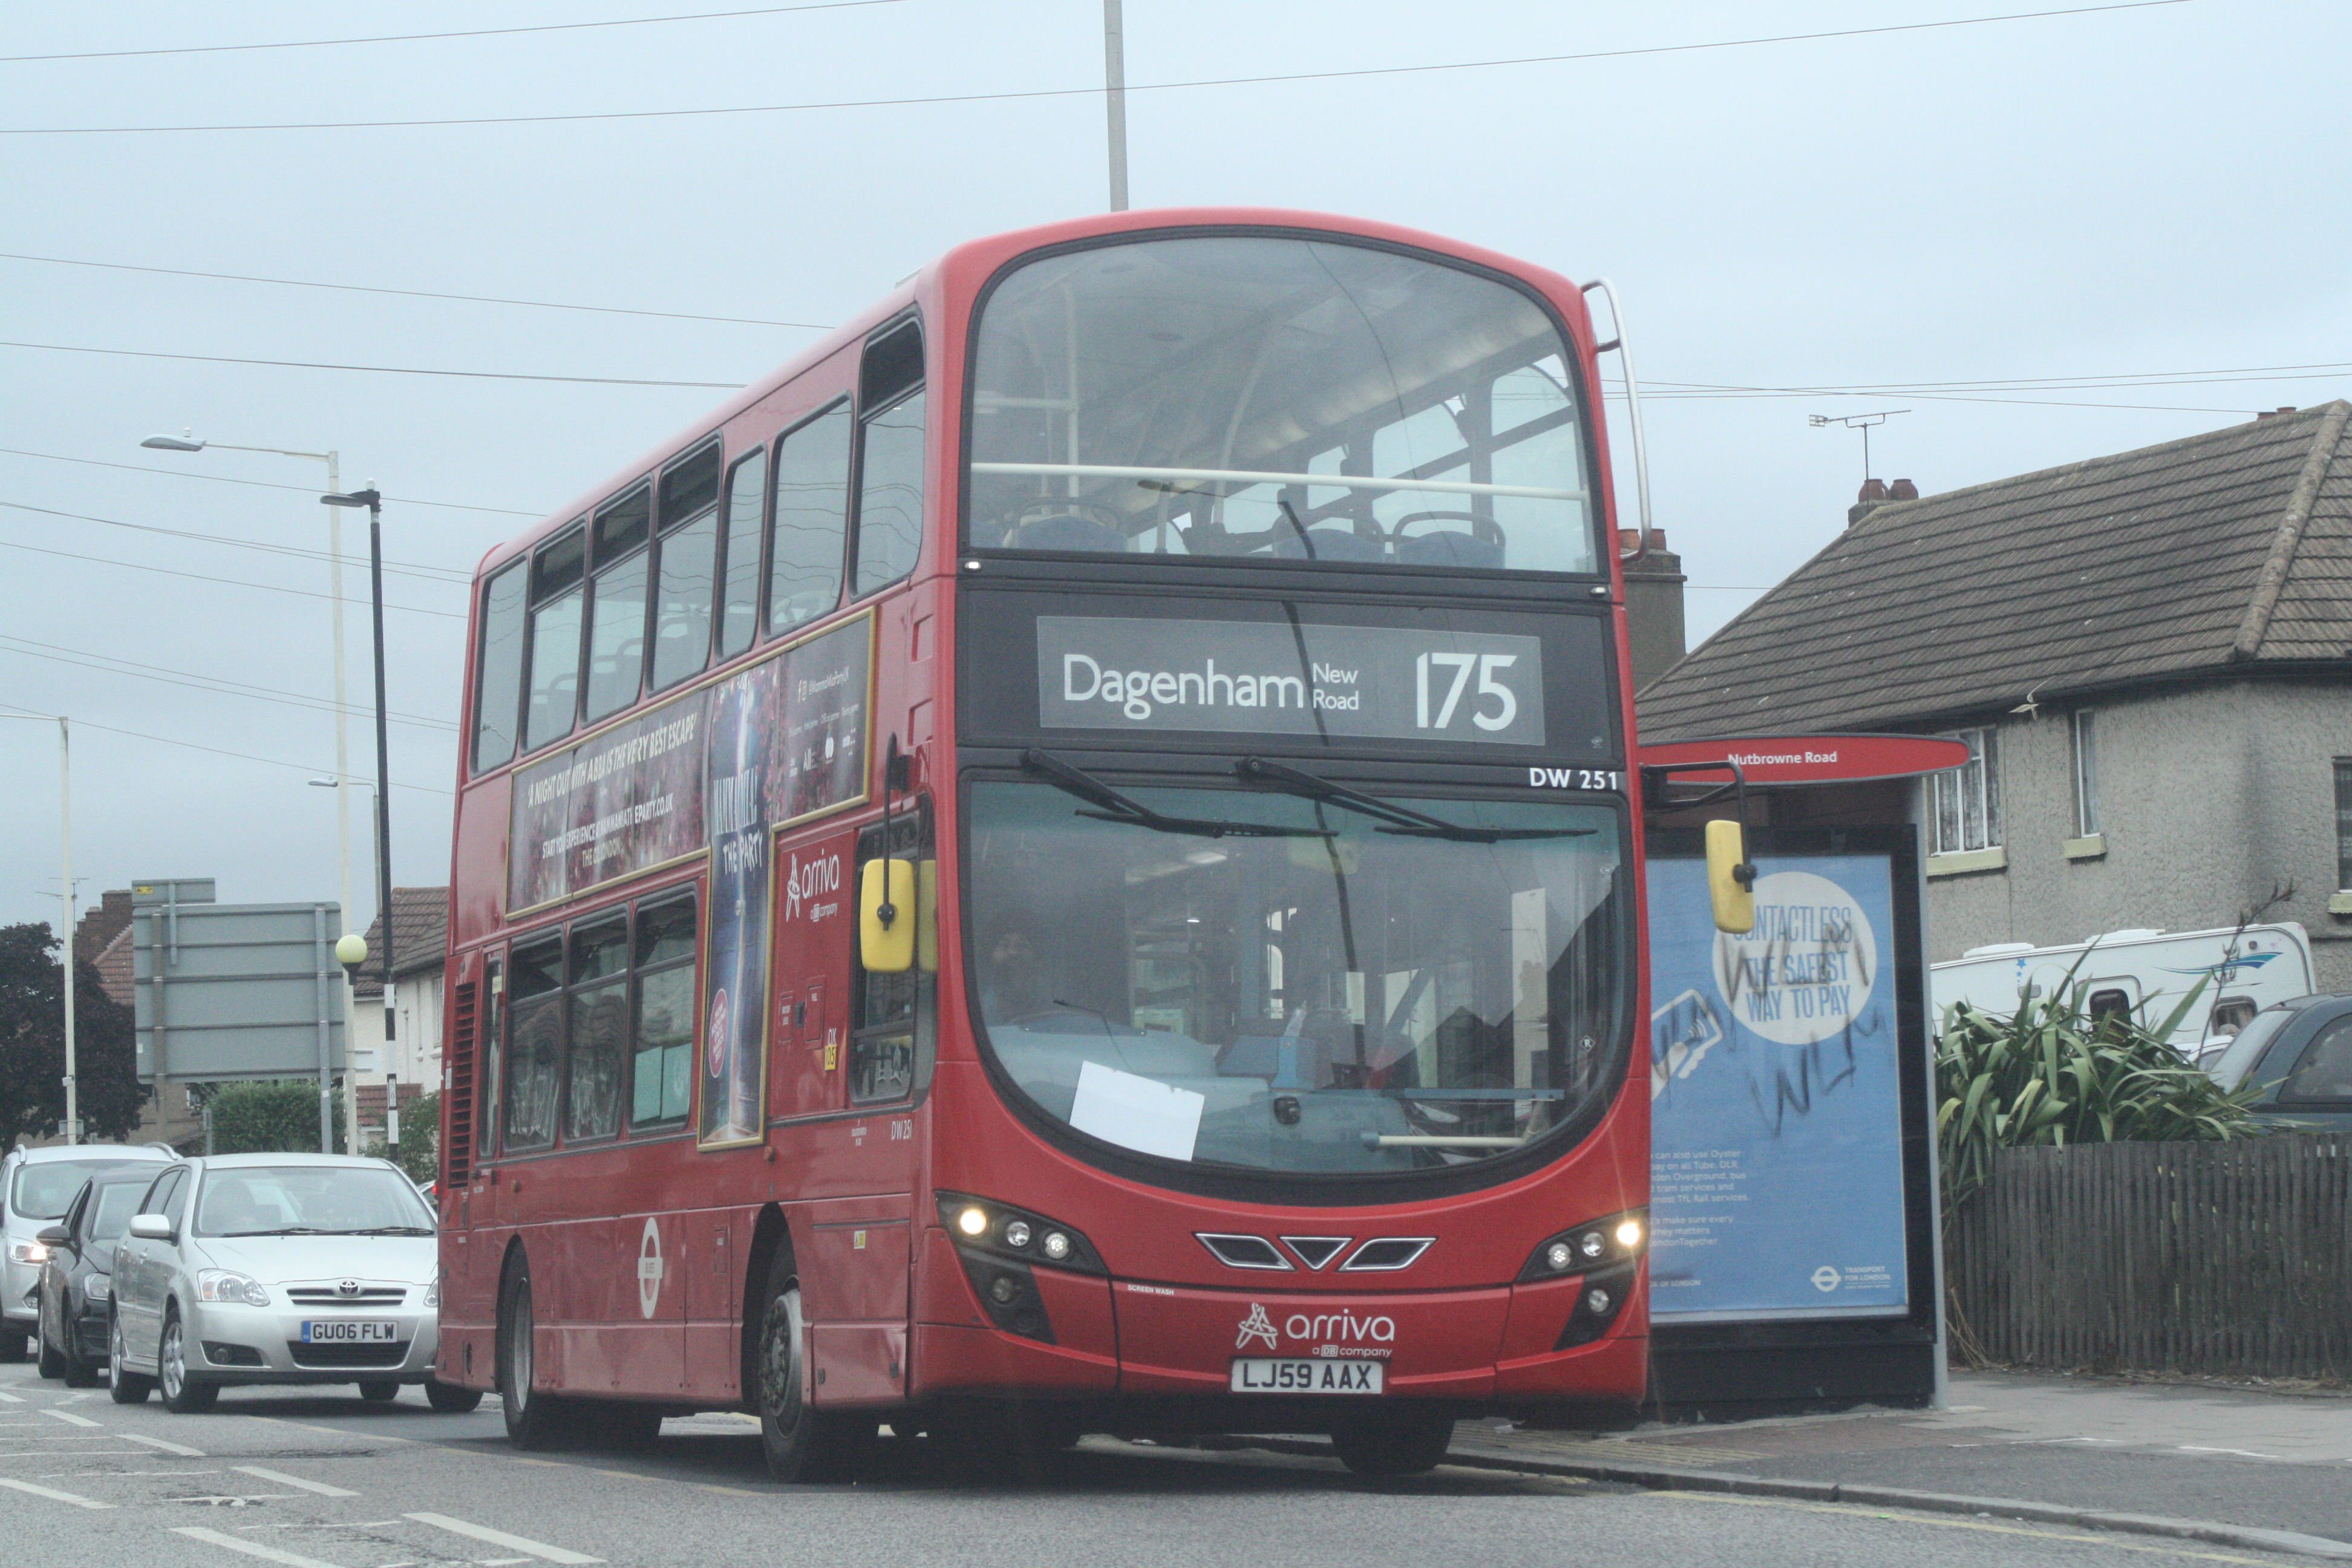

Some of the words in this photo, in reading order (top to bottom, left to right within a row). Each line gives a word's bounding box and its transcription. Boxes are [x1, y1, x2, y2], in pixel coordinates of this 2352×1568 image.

[1063, 653, 1304, 720] Dagenham
[1313, 663, 1357, 685] New
[1416, 651, 1518, 731] 175
[1313, 688, 1359, 711] Road
[534, 775, 557, 806] NIGHT
[557, 769, 571, 797] OUT
[571, 761, 587, 789] WITH
[586, 754, 606, 784] ABBA
[606, 749, 613, 776] IS
[613, 743, 627, 772] THE
[627, 733, 650, 766] VERY
[649, 727, 667, 759] BEST
[1728, 753, 1802, 765] Nutbrowne
[1805, 751, 1837, 763] Road
[1529, 768, 1572, 789] DW
[1579, 770, 1617, 790] 251
[542, 838, 555, 859] START
[566, 823, 595, 849] EXPERIENCE
[723, 841, 737, 875] THE
[739, 829, 763, 872] PARTY
[582, 848, 593, 867] THE
[802, 848, 840, 900] arriva
[1733, 905, 1852, 943] NTACTLESS
[1742, 956, 1779, 988] THE
[1785, 950, 1848, 985] SAFEST
[1745, 990, 1783, 1022] WAY
[1789, 987, 1814, 1019] TO
[1818, 984, 1851, 1017] PAY
[828, 1028, 837, 1045] DX
[891, 1120, 903, 1140] DW
[903, 1119, 912, 1140] 251
[1710, 1149, 1741, 1158] Oyster
[1128, 1284, 1154, 1293] SCREEN
[313, 1324, 357, 1339] GU06
[362, 1324, 394, 1339] FLW
[1285, 1308, 1395, 1341] arriva
[1322, 1346, 1338, 1356] DB
[1339, 1347, 1393, 1357] company
[1243, 1362, 1312, 1388] LJ59
[1321, 1364, 1371, 1389] AAX
